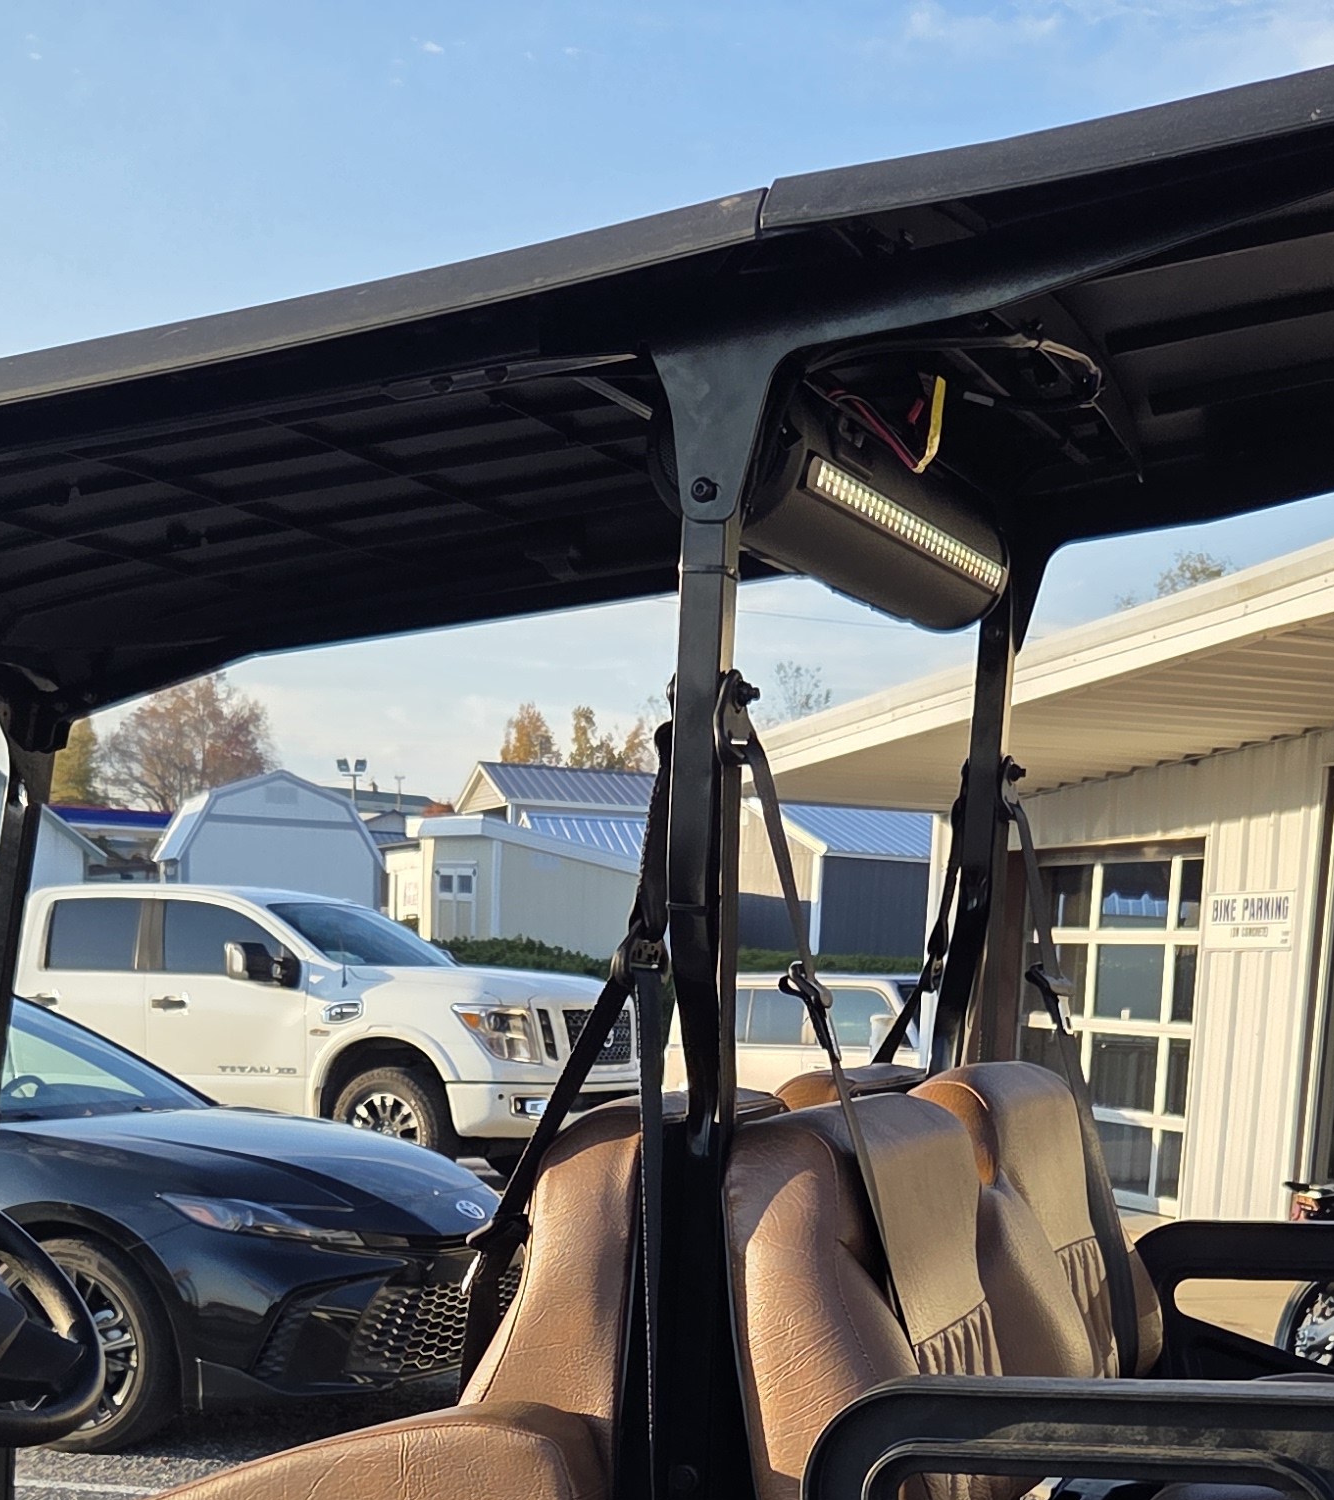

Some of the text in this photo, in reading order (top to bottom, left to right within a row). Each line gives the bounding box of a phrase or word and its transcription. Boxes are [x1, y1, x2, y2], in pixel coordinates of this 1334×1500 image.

[1211, 896, 1289, 922] BIKE PARKING
[217, 1065, 297, 1075] TITAN XD
